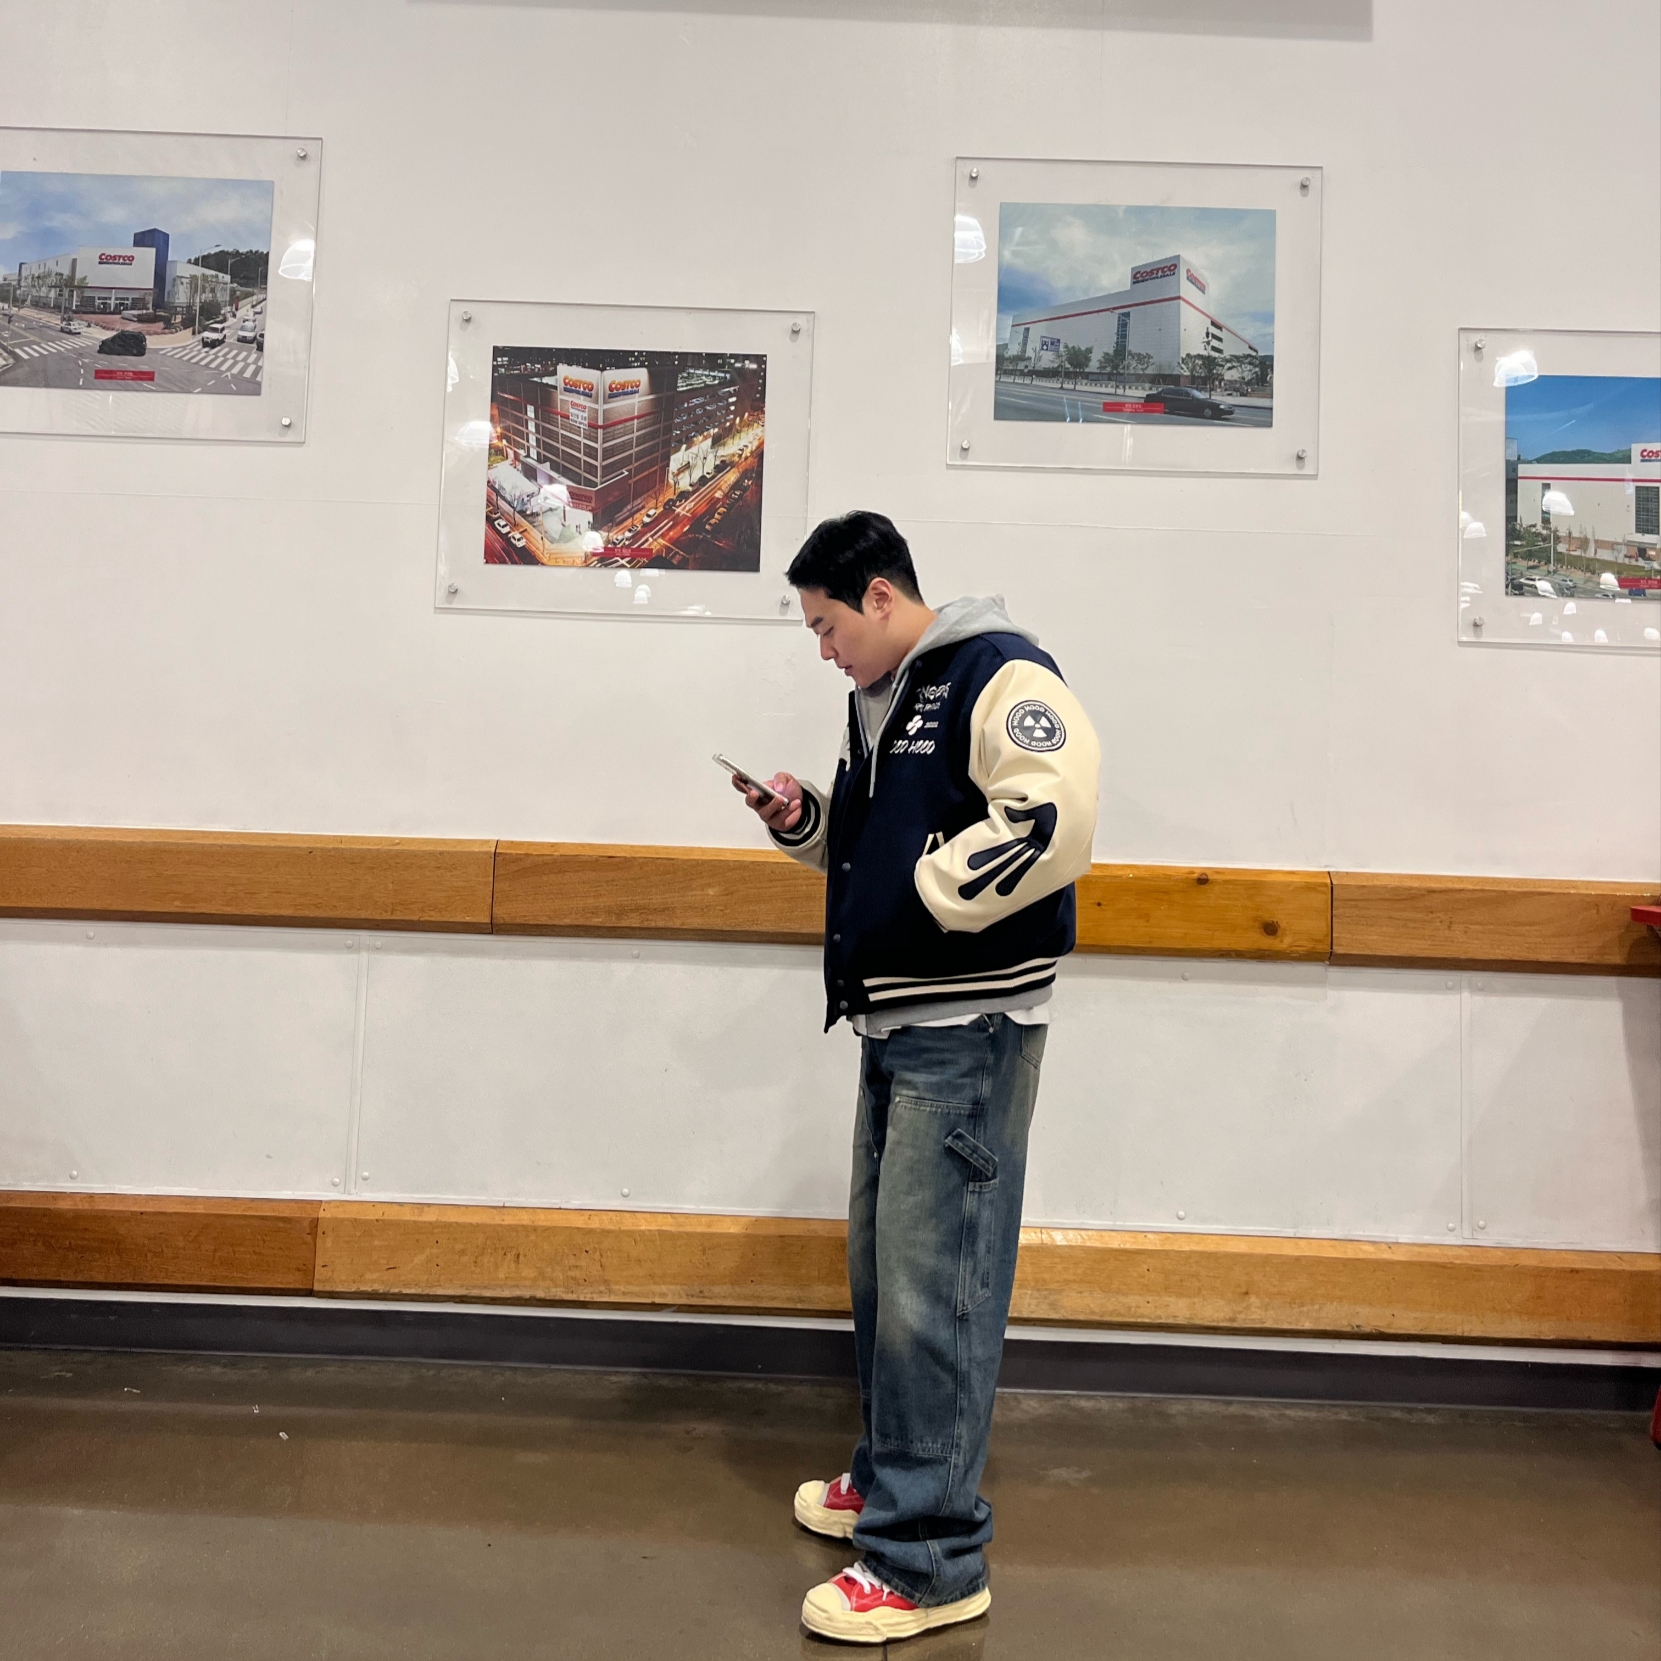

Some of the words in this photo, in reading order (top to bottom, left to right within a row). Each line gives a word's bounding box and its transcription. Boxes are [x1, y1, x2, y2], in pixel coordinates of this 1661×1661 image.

[98, 252, 135, 262] COSTCO
[1132, 263, 1178, 280] COSTCO
[563, 375, 594, 392] COSTCO
[608, 379, 641, 393] COSTCO
[1640, 448, 1661, 458] COS
